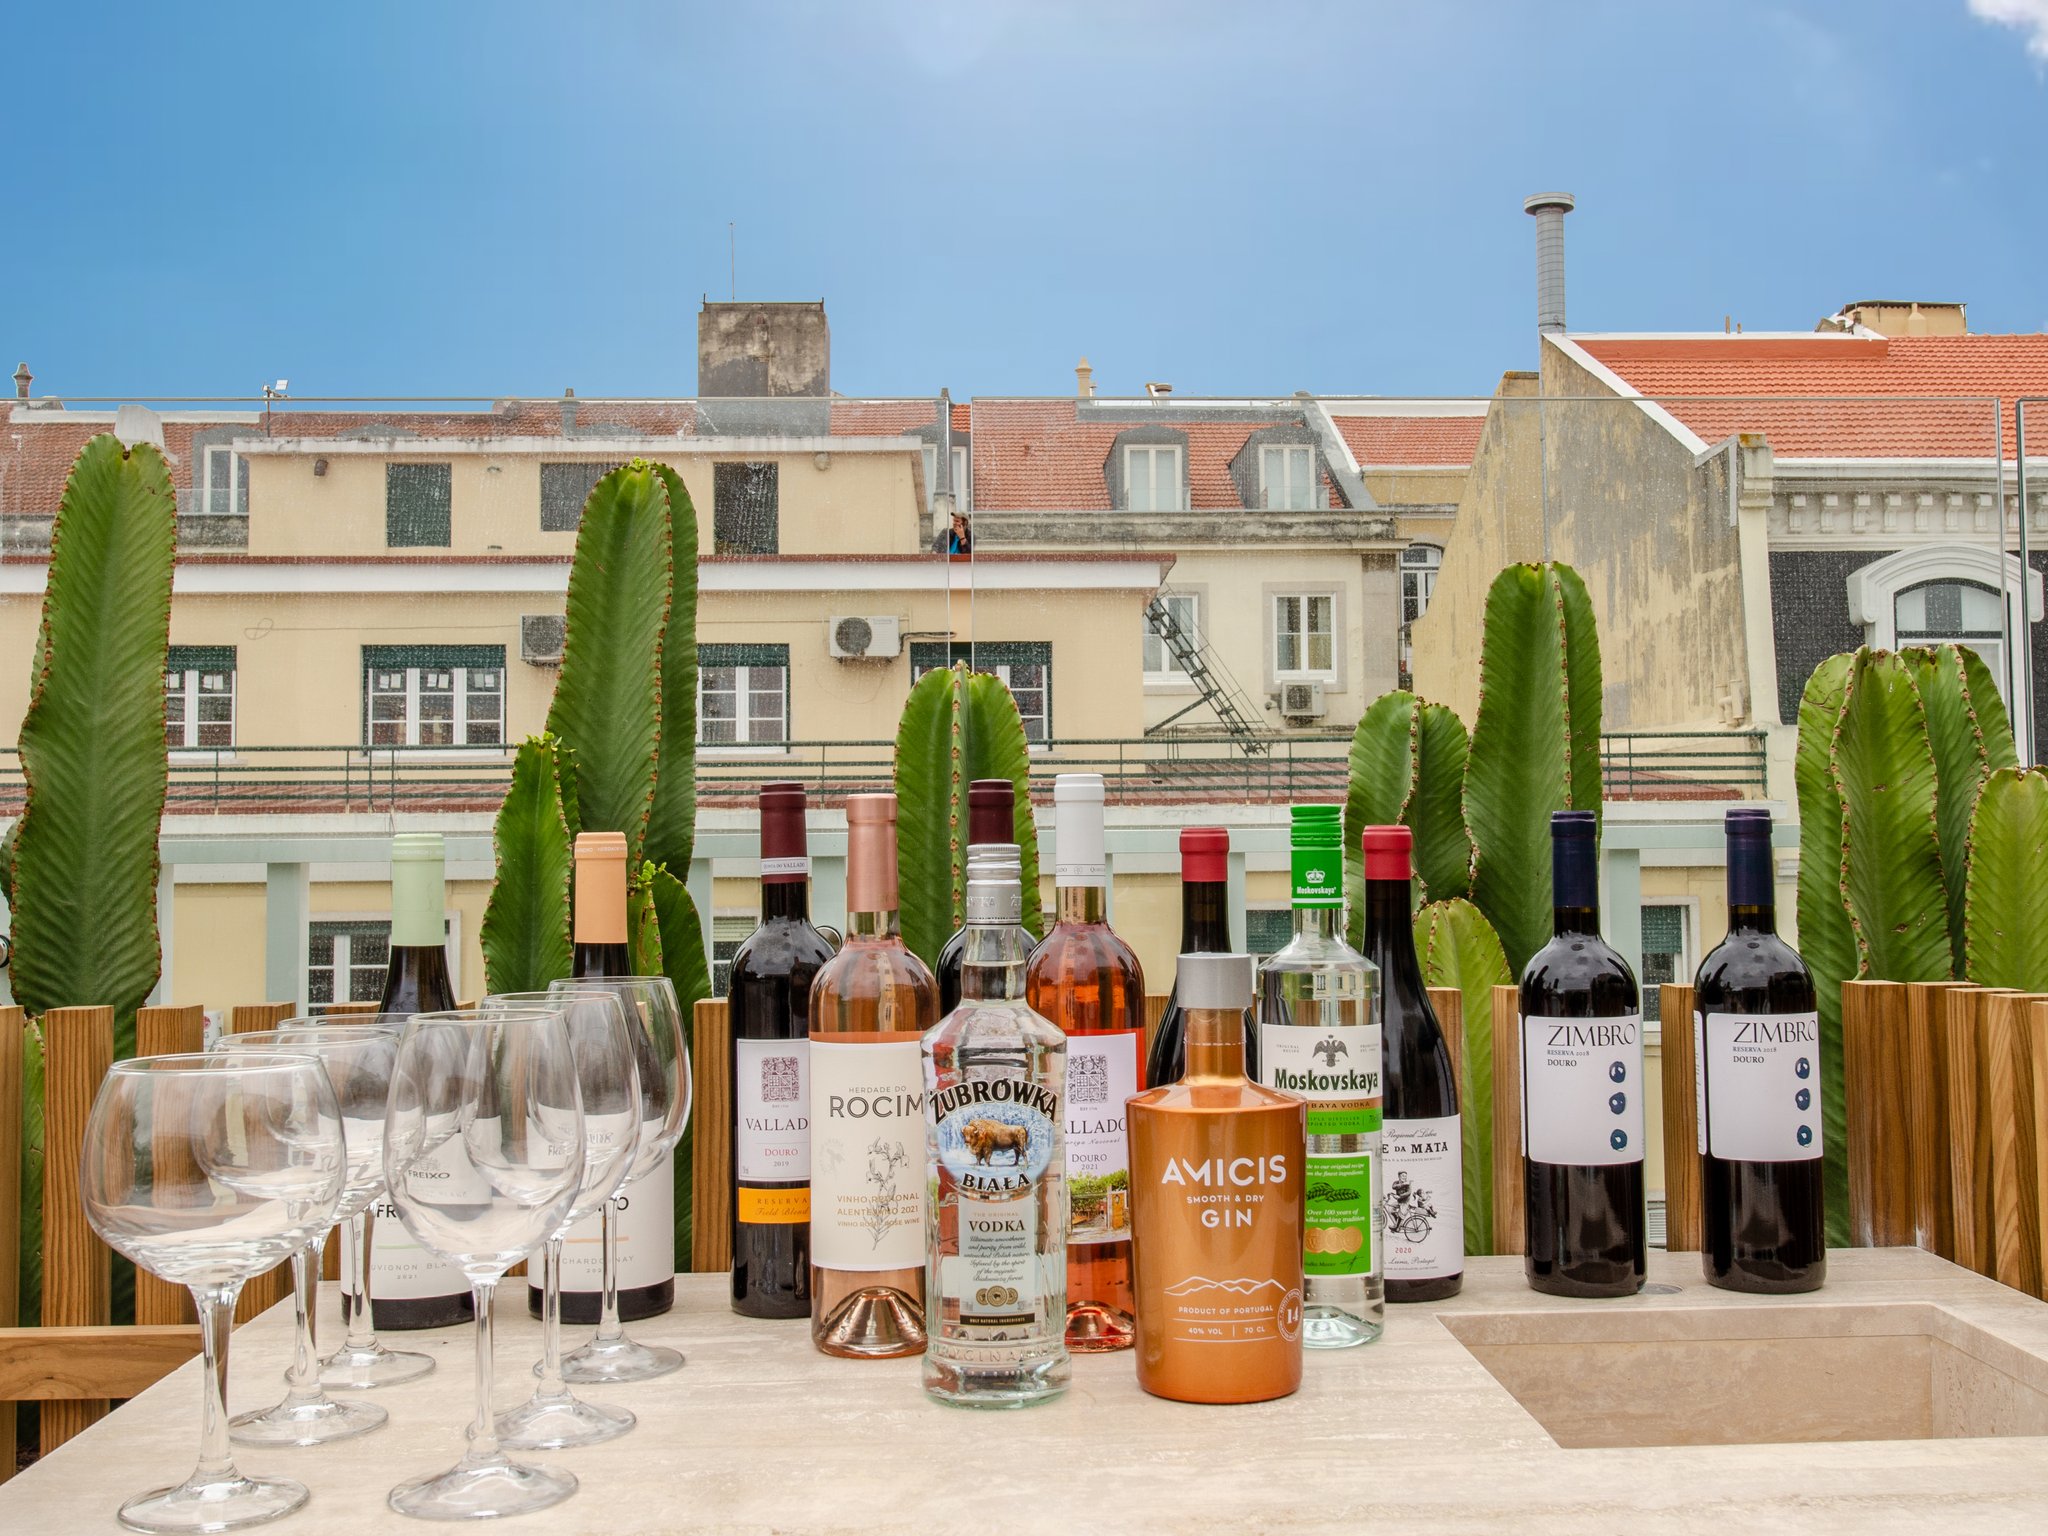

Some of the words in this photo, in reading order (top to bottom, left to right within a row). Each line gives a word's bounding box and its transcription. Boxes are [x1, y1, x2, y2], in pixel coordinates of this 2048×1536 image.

[1296, 886, 1337, 896] Moskovskaya
[1547, 1023, 1636, 1047] ZIMBRO
[1733, 1020, 1817, 1043] ZIMBRO
[1547, 1059, 1577, 1067] DOURO
[1733, 1056, 1765, 1064] DOURO
[1274, 1068, 1378, 1095] Moskovskaya
[895, 1085, 907, 1093] DO
[829, 1093, 924, 1118] ROCIM
[929, 1078, 1058, 1125] ŻUBRÓWKA
[1341, 1101, 1370, 1109] VODKA
[745, 1117, 809, 1131] VALLAD
[1065, 1117, 1126, 1134] LLADO
[764, 1148, 798, 1157] DOURO
[1411, 1142, 1449, 1154] MATA
[1072, 1153, 1108, 1163] DOURO
[408, 1169, 451, 1180] FREIXO
[1161, 1154, 1287, 1187] AMICIS
[962, 1173, 1031, 1191] BIAŁA
[836, 1195, 868, 1204] VINHO
[1186, 1194, 1231, 1204] SMOOTH
[1234, 1195, 1241, 1203] &
[1245, 1194, 1265, 1203] DRY
[901, 1205, 919, 1214] 2021
[904, 1217, 920, 1225] WINE
[1201, 1208, 1252, 1228] GIN
[968, 1219, 1026, 1233] VODKA
[561, 1255, 634, 1265] CHARDONAY
[1178, 1306, 1216, 1315] PRODUCT
[1233, 1304, 1273, 1314] PORTUGAL
[1286, 1305, 1299, 1324] 14
[1188, 1327, 1205, 1335] 40%
[1207, 1327, 1223, 1336] VOL
